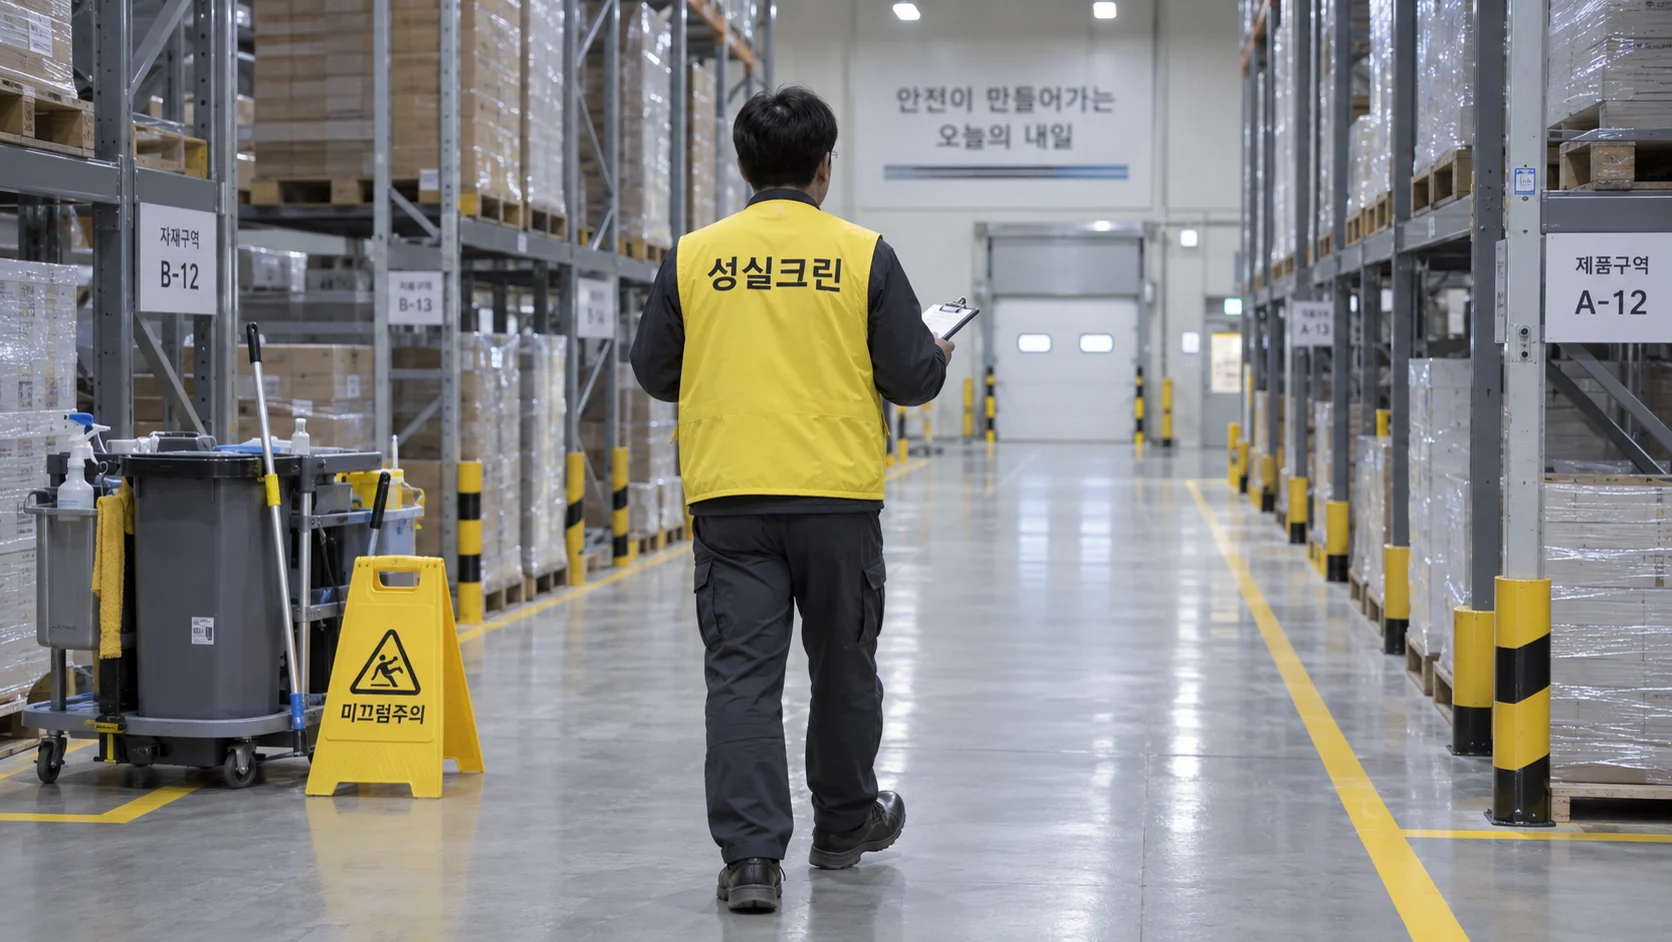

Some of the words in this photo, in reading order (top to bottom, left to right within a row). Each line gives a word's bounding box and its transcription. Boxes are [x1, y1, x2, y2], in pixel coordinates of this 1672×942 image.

[896, 87, 973, 113] 안전이
[986, 86, 1116, 114] 만들어가는
[936, 124, 1011, 150] 오늘의
[1024, 123, 1073, 150] 내일
[160, 226, 200, 250] 자재구역
[160, 260, 199, 291] B-12
[707, 256, 843, 293] 성실크린
[1575, 255, 1649, 276] 제품구역
[399, 297, 432, 313] B-13
[1574, 289, 1648, 315] A-12
[340, 702, 426, 725] 미끄럼주의
